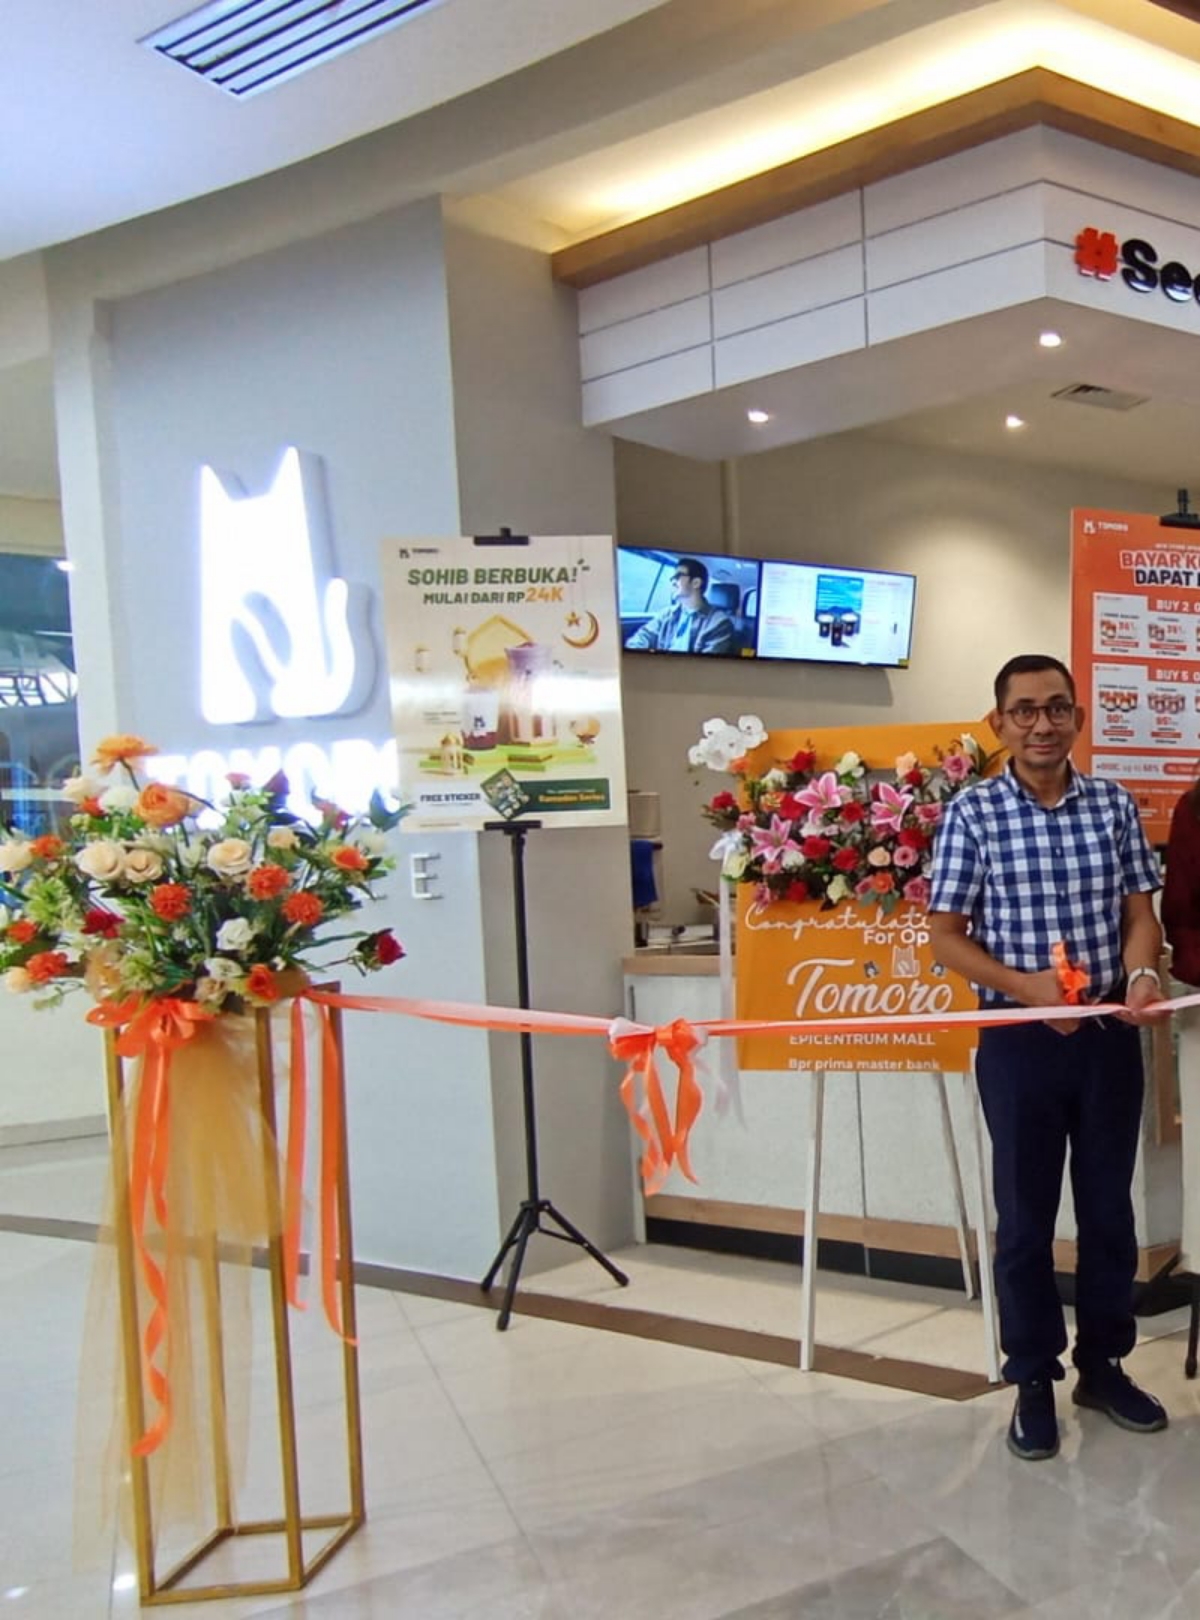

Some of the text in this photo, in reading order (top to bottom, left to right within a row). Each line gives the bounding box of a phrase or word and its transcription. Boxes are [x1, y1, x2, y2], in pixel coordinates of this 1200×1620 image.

[1121, 552, 1181, 570] BAYAR
[407, 567, 578, 585] SOHIB BERBUKA!
[1134, 569, 1194, 586] DAPAT
[423, 592, 468, 604] MULAI
[470, 592, 505, 604] DARI
[1156, 599, 1179, 611] BUY
[1182, 601, 1189, 612] 2
[1156, 669, 1179, 680] BUY
[420, 793, 481, 802] FREE STICKER
[863, 930, 895, 944] For
[787, 958, 953, 1018] Tomoro
[892, 1032, 936, 1045] MALL
[815, 1057, 853, 1070] prima
[856, 1058, 903, 1070] master
[906, 1057, 940, 1070] bank
